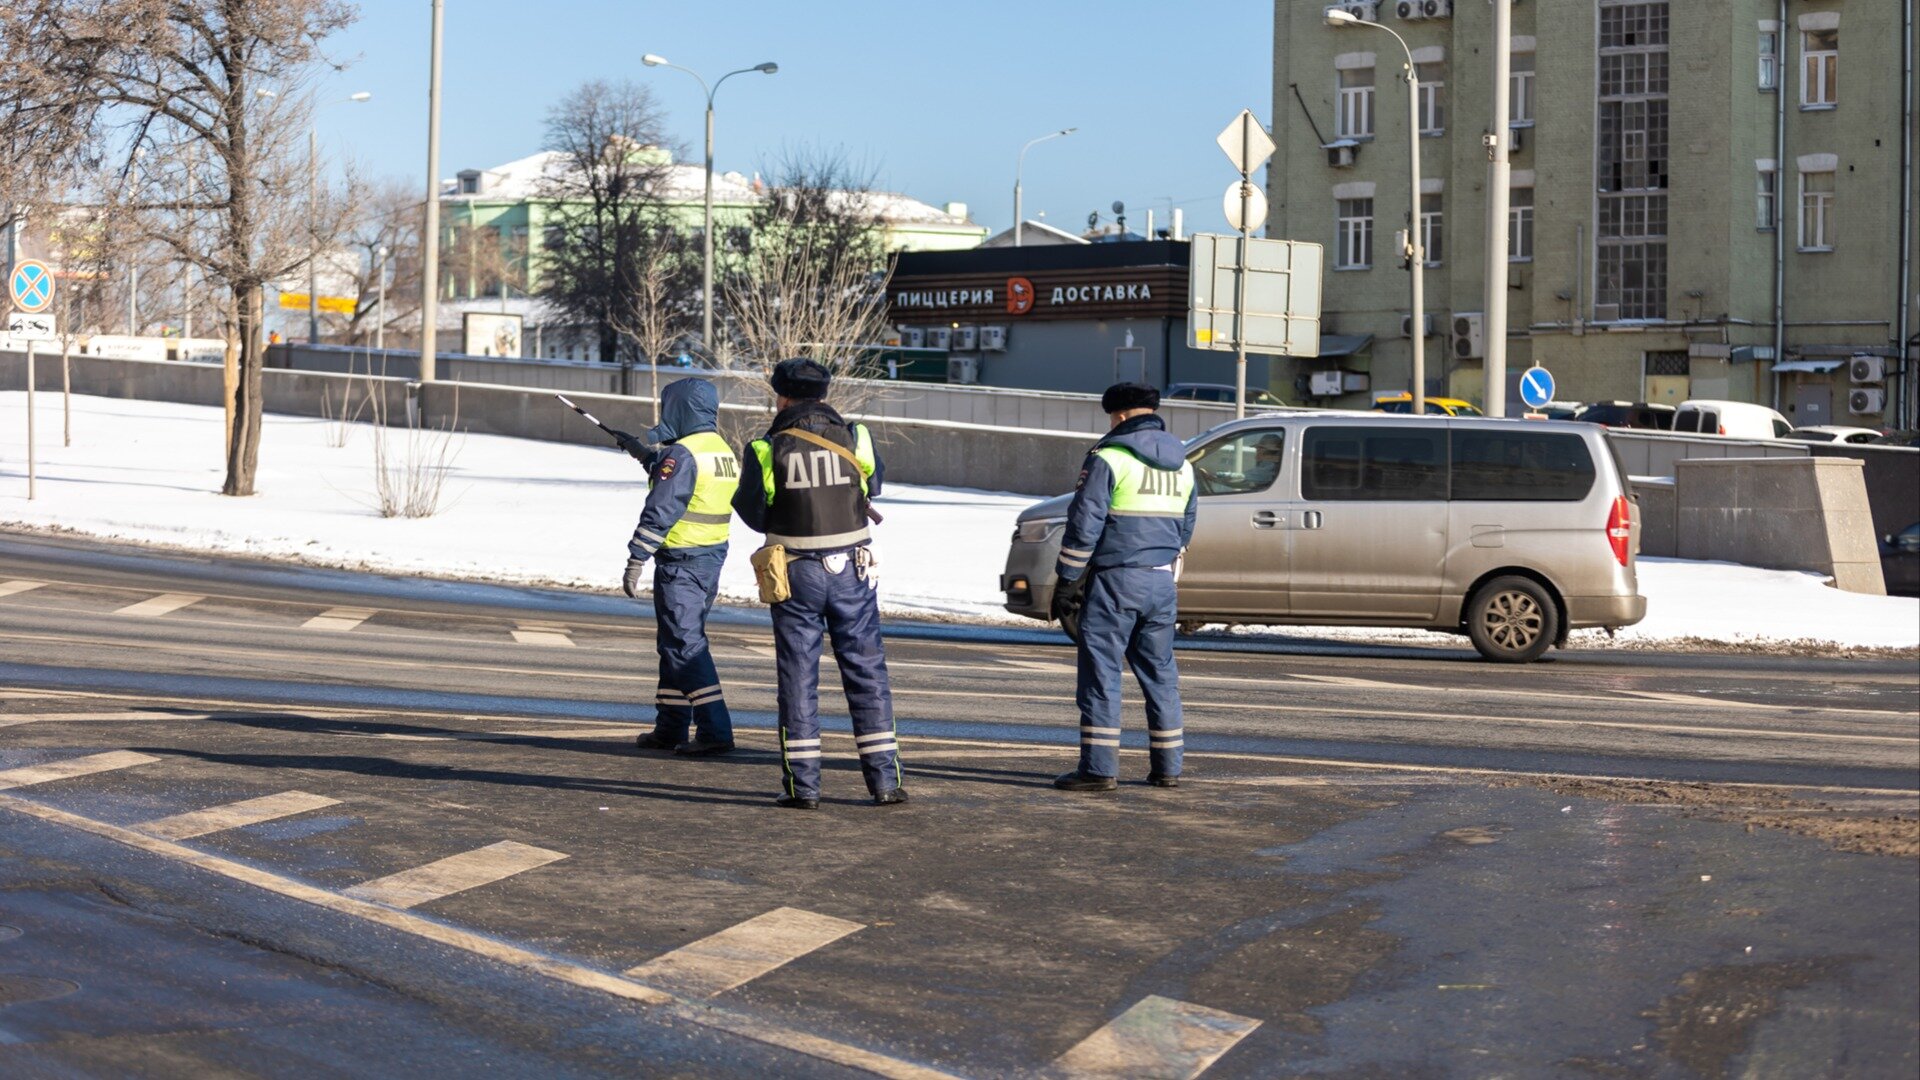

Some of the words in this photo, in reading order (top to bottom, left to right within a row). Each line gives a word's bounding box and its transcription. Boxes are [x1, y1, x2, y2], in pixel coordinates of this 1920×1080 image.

[898, 289, 993, 308] ПИЦЦЕРИЯ
[1051, 284, 1151, 305] ДОСТАВКА
[714, 456, 737, 478] ДПС
[1138, 467, 1183, 497] ДПС
